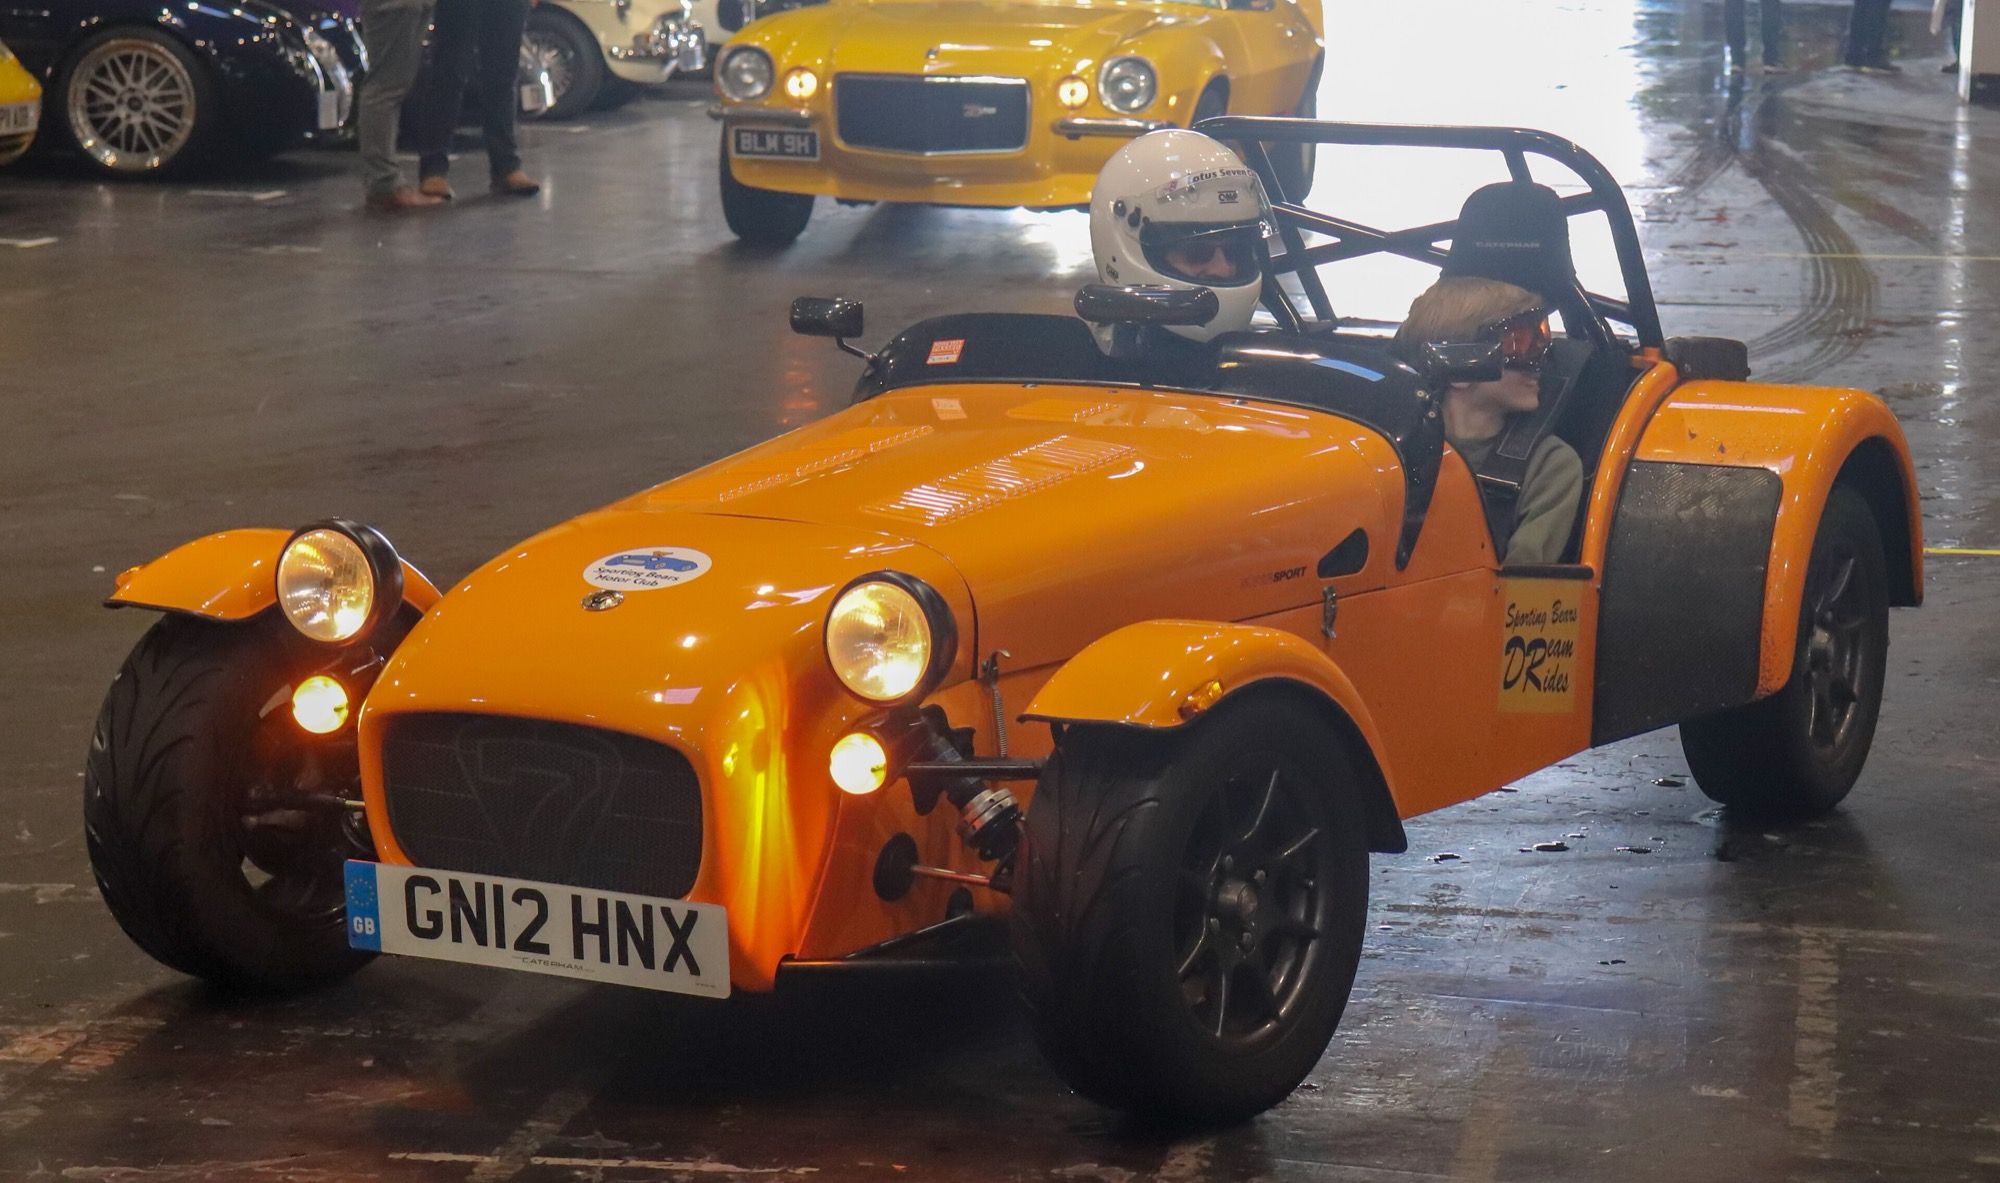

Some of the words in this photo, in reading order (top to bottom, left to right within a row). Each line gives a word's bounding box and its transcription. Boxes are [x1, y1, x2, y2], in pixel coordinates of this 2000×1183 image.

[1220, 169, 1246, 177] Seven
[594, 567, 644, 578] Sporting
[647, 571, 680, 582] Bears
[595, 574, 631, 583] Motor
[633, 577, 659, 587] Club
[1506, 602, 1547, 633] Sporting
[1551, 600, 1577, 624] Bears
[353, 916, 375, 935] GB
[404, 875, 550, 956] GN12
[571, 893, 701, 977] HNX
[521, 956, 584, 971] CATERHAM
